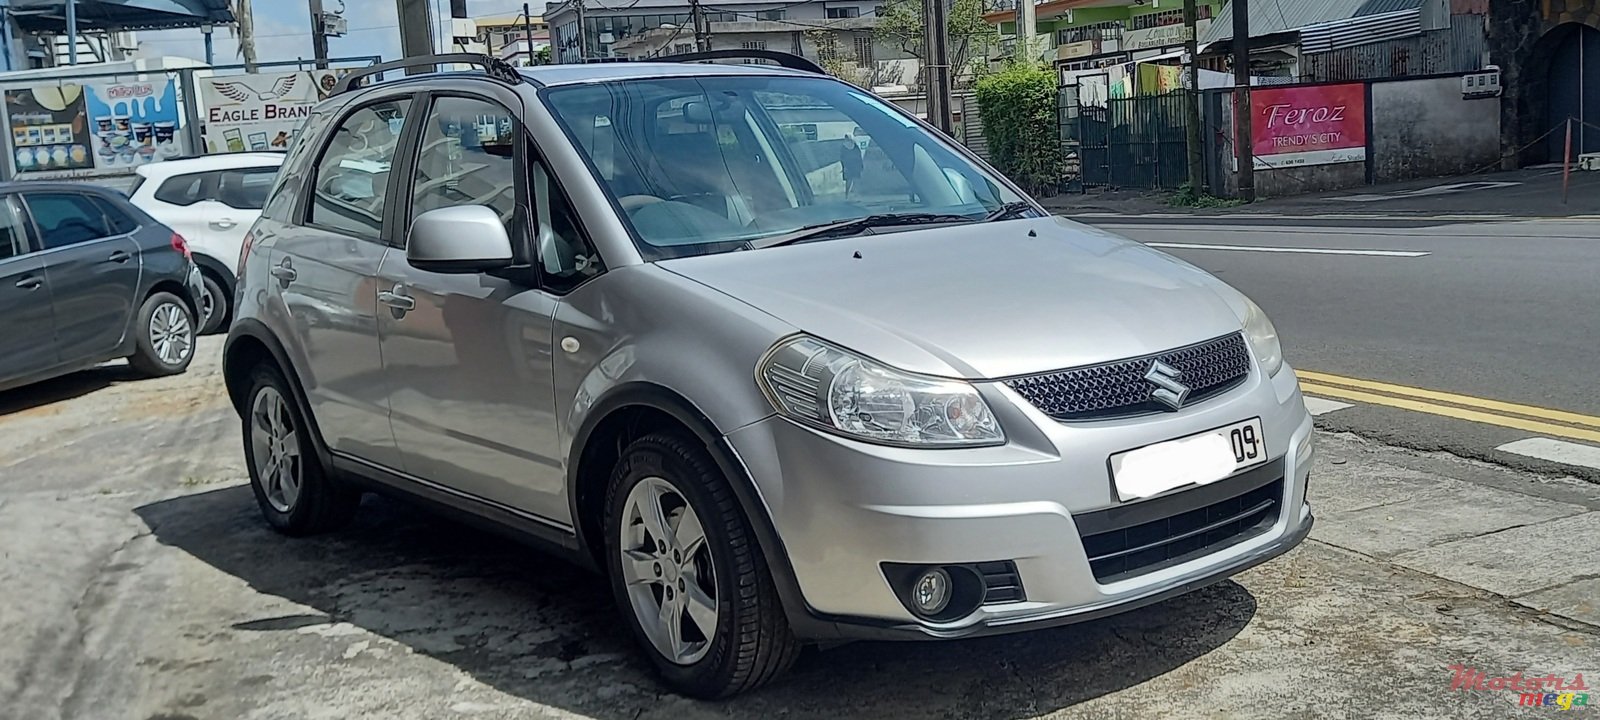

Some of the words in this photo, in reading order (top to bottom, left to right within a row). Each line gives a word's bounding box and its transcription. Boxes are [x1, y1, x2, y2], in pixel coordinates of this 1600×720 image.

[209, 107, 259, 123] EAGLE
[1262, 103, 1346, 129] Feroz
[1272, 134, 1318, 147] TRENDY'S
[1320, 131, 1341, 143] CITY
[1231, 425, 1257, 463] 09
